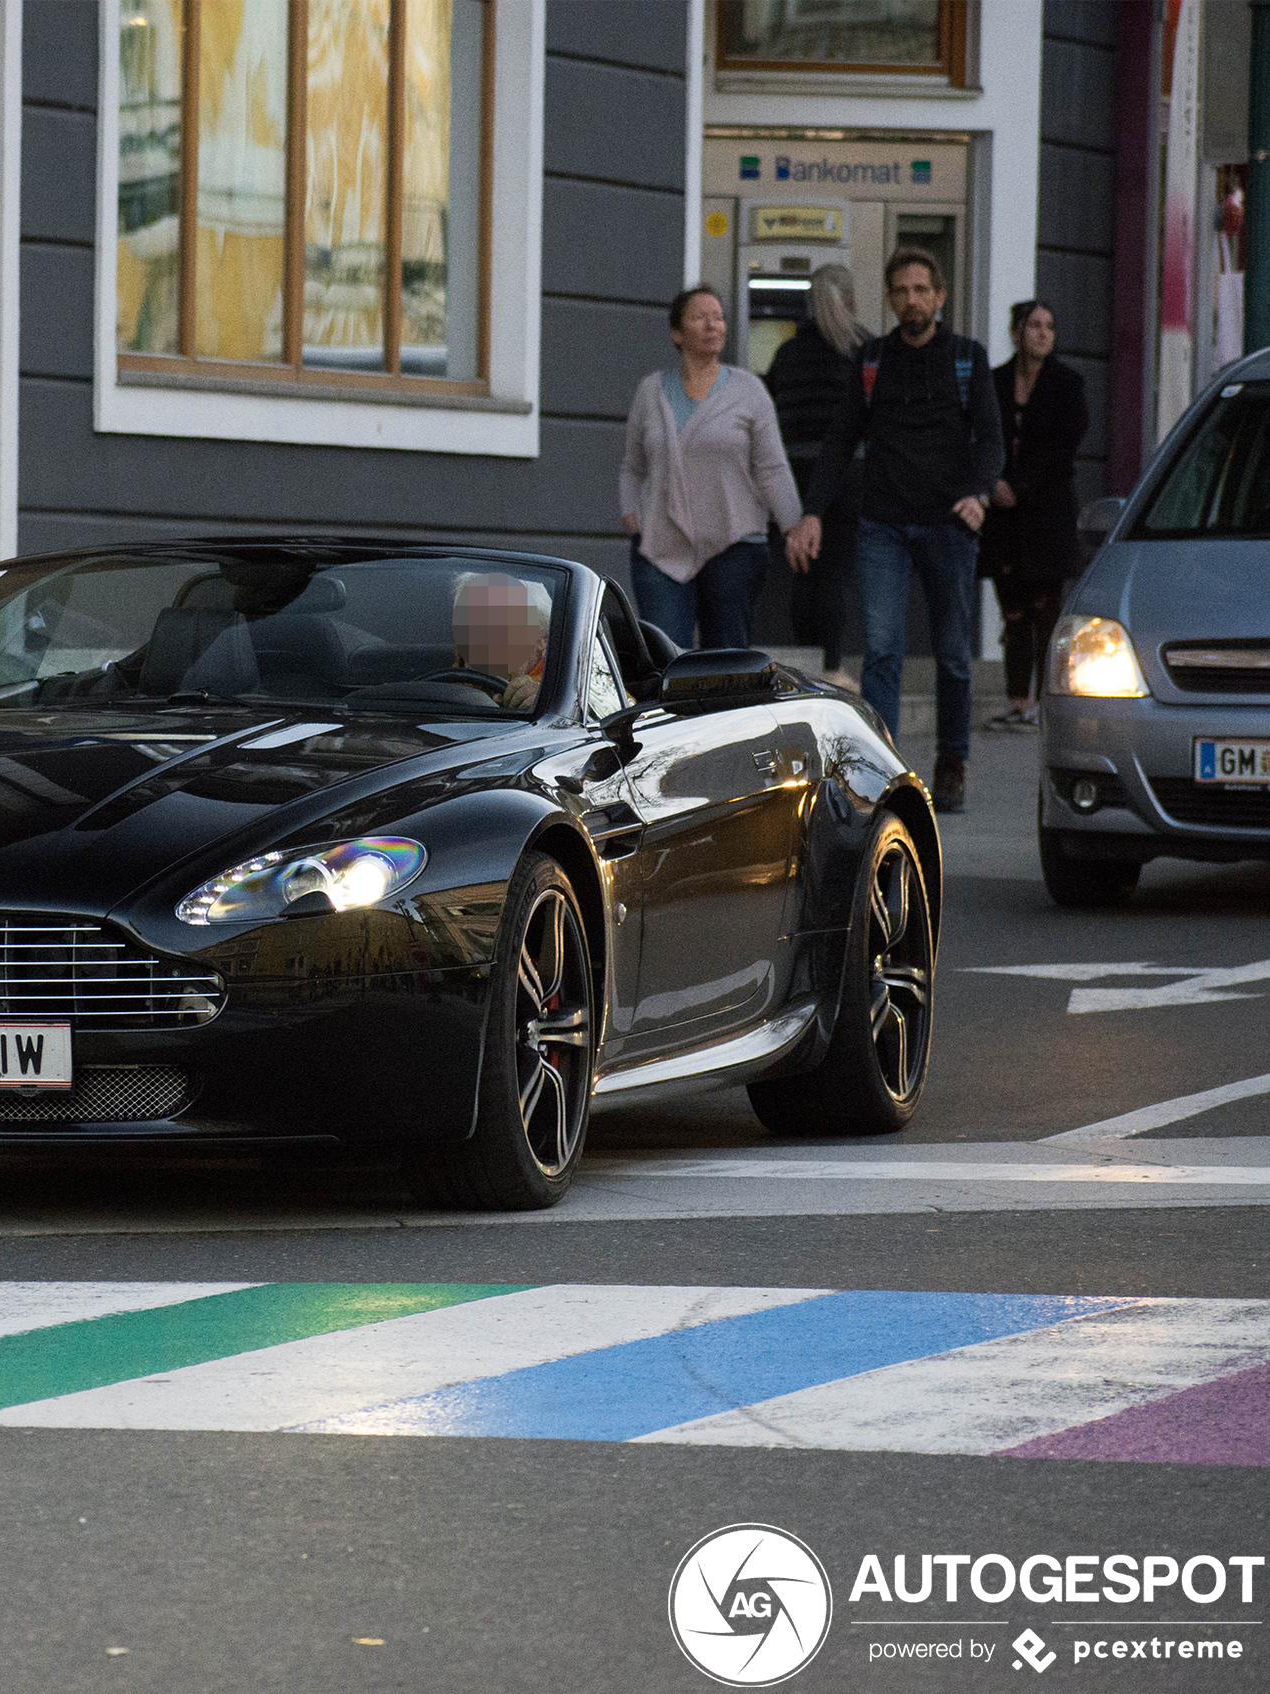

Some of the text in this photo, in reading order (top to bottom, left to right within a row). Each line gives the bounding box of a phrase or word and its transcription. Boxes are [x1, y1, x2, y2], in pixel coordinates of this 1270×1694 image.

[776, 156, 900, 185] Bankomat
[1204, 765, 1212, 774] A
[1221, 747, 1255, 775] GM
[0, 1033, 44, 1076] IW
